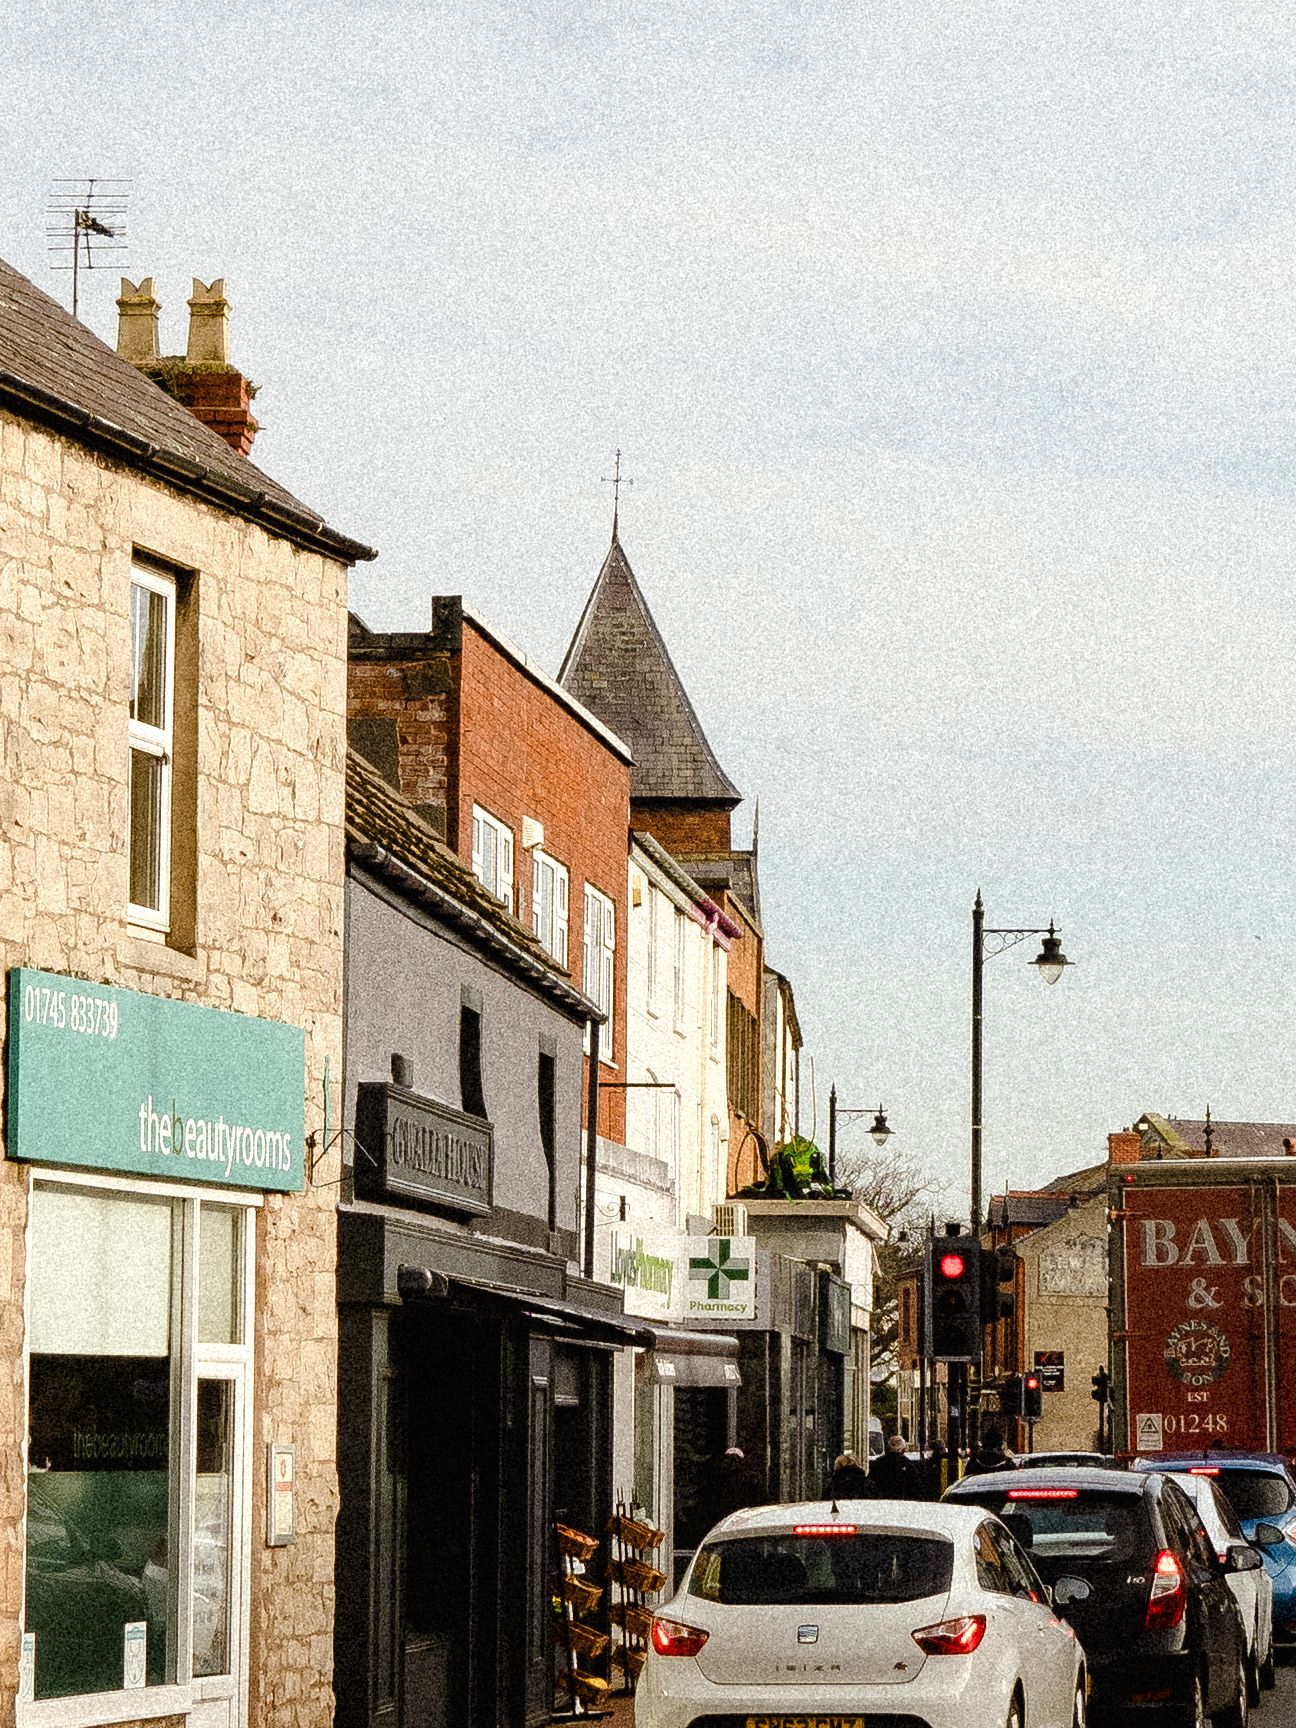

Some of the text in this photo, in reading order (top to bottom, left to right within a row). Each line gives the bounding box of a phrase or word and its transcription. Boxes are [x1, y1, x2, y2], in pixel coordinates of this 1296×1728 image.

[24, 984, 119, 1040] 01745 833739
[139, 1095, 292, 1177] thebeautyrooms
[1186, 1276, 1224, 1309] &
[689, 1300, 748, 1313] Pharmacy
[1187, 1391, 1211, 1403] EST
[1164, 1413, 1228, 1433] 01248
